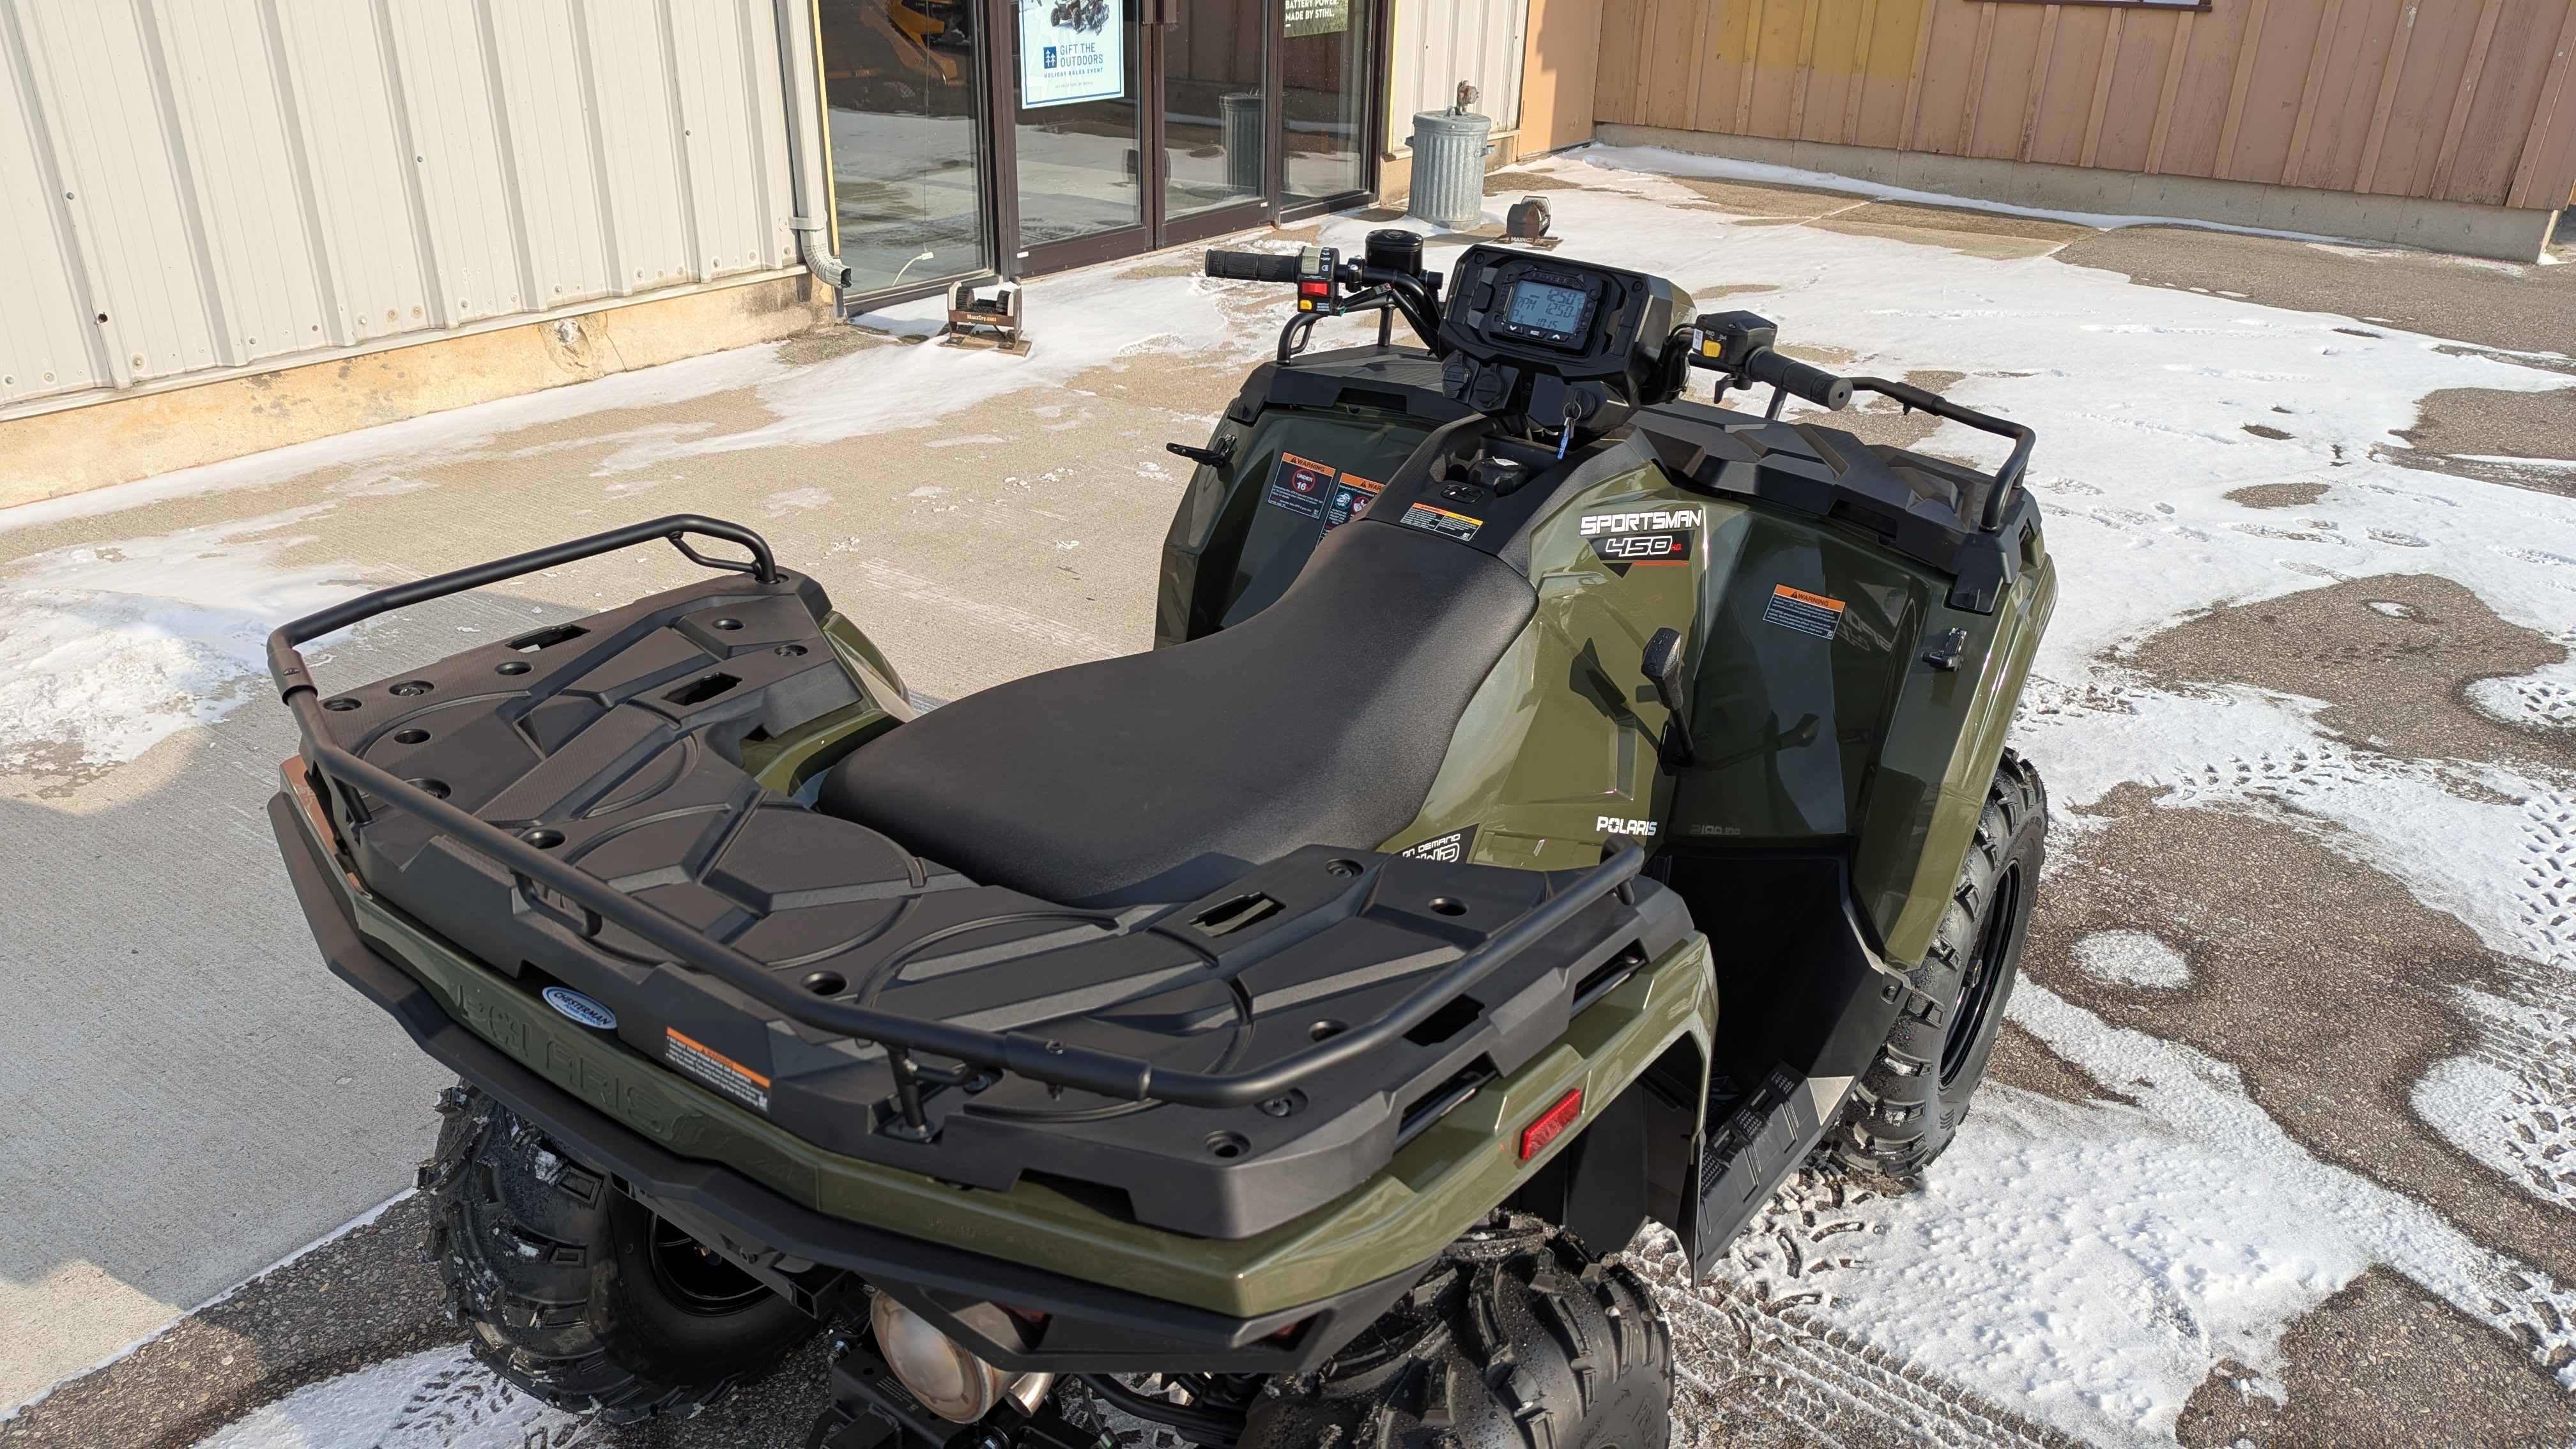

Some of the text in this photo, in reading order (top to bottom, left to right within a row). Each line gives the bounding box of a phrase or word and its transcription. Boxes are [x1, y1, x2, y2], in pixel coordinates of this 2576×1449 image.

[1285, 0, 1313, 9] BATTERY
[1285, 8, 1335, 21] MADE BY STIHL.
[1061, 42, 1096, 55] GIFT THE
[1061, 54, 1103, 68] OUTDOORS
[1547, 288, 1577, 305] 1250
[1545, 303, 1574, 318] 1250
[1298, 459, 1325, 473] WARNING
[1296, 473, 1314, 482] UNDER
[1297, 481, 1307, 491] 16
[1368, 482, 1382, 491] WAR
[1580, 509, 1703, 535] SPORTSMAN
[1606, 535, 1673, 557] 450
[1798, 592, 1829, 607] WARNING
[1596, 816, 1658, 836] POLARIS
[1418, 833, 1460, 853] DEMAND
[554, 992, 611, 1025] CHESTERMAN
